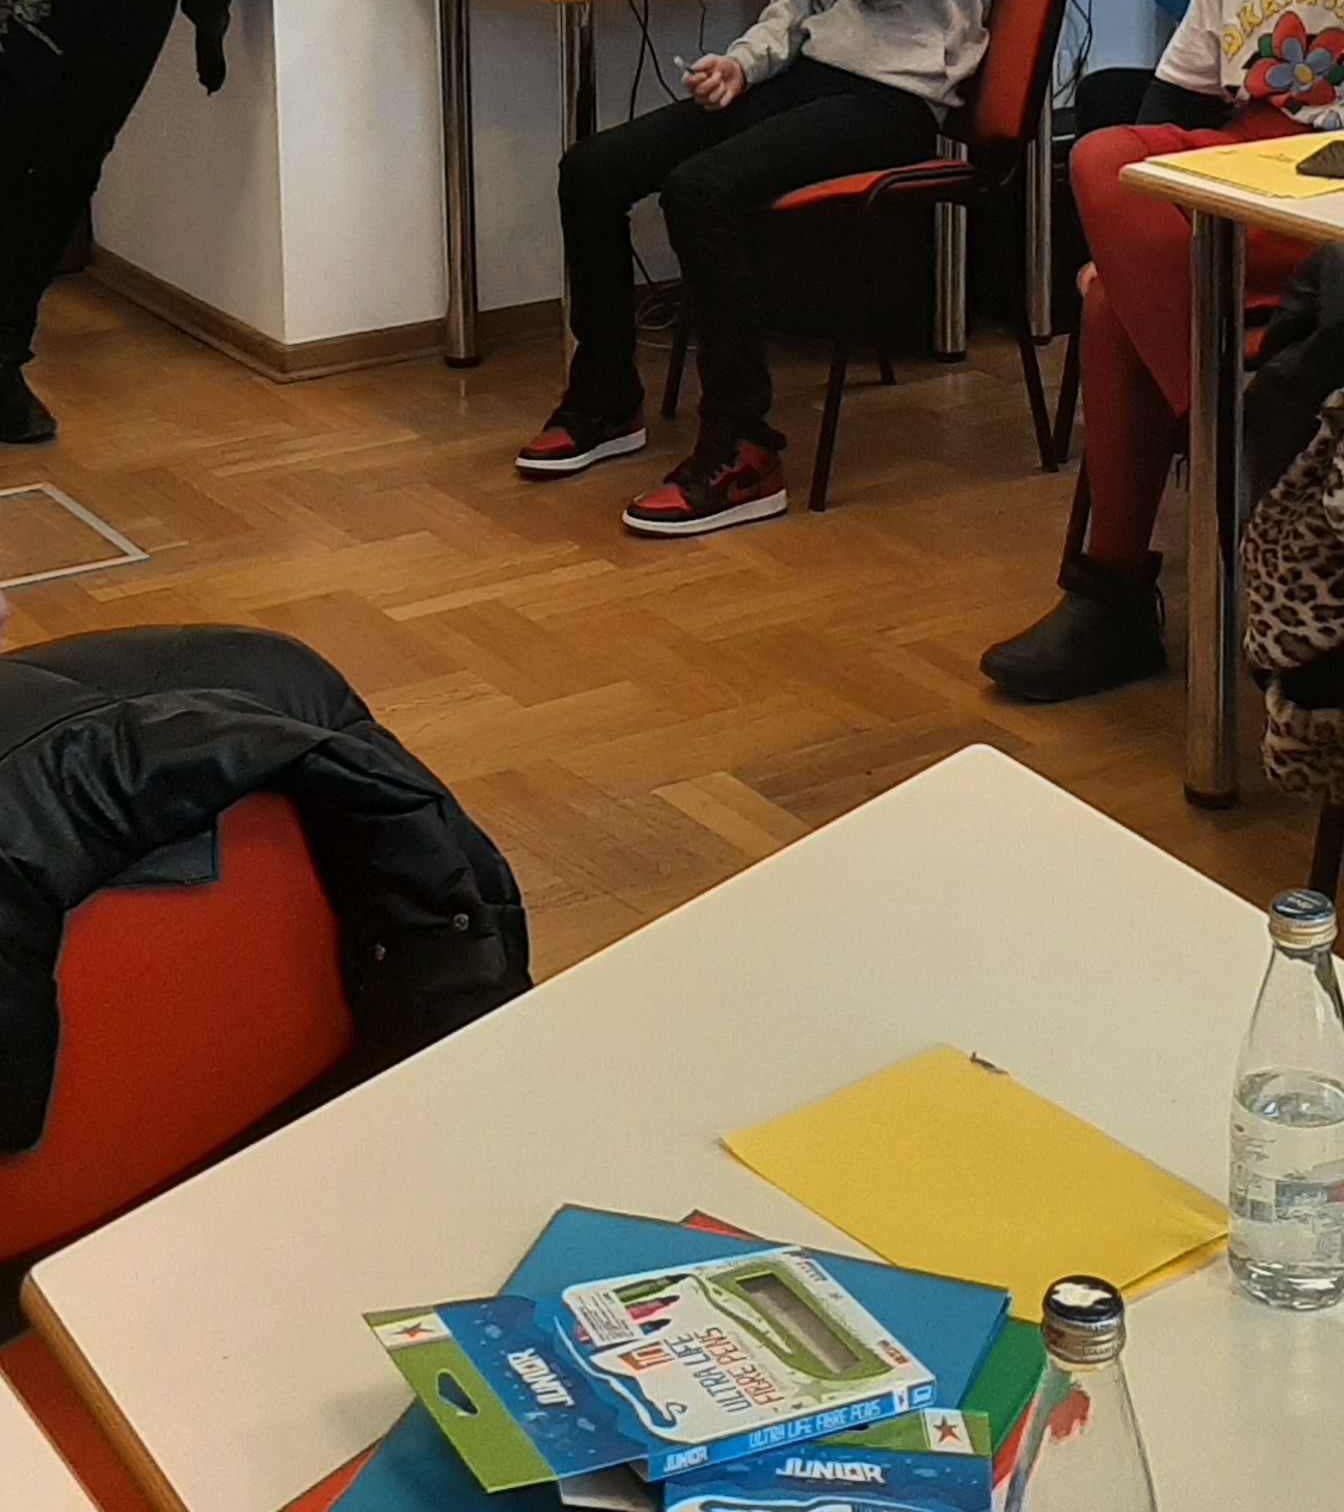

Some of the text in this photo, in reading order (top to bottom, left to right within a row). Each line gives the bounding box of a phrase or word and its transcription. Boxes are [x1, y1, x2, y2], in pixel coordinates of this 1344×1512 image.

[662, 1331, 754, 1414] ULTRA LIFE
[693, 1326, 748, 1365] PENS
[506, 1347, 576, 1407] JUNIOR
[663, 1445, 709, 1473] JUNIOR
[747, 1425, 786, 1450] ULTRA
[787, 1417, 814, 1440] LIFE
[850, 1398, 882, 1422] PENS
[774, 1457, 886, 1485] JUNIOR
